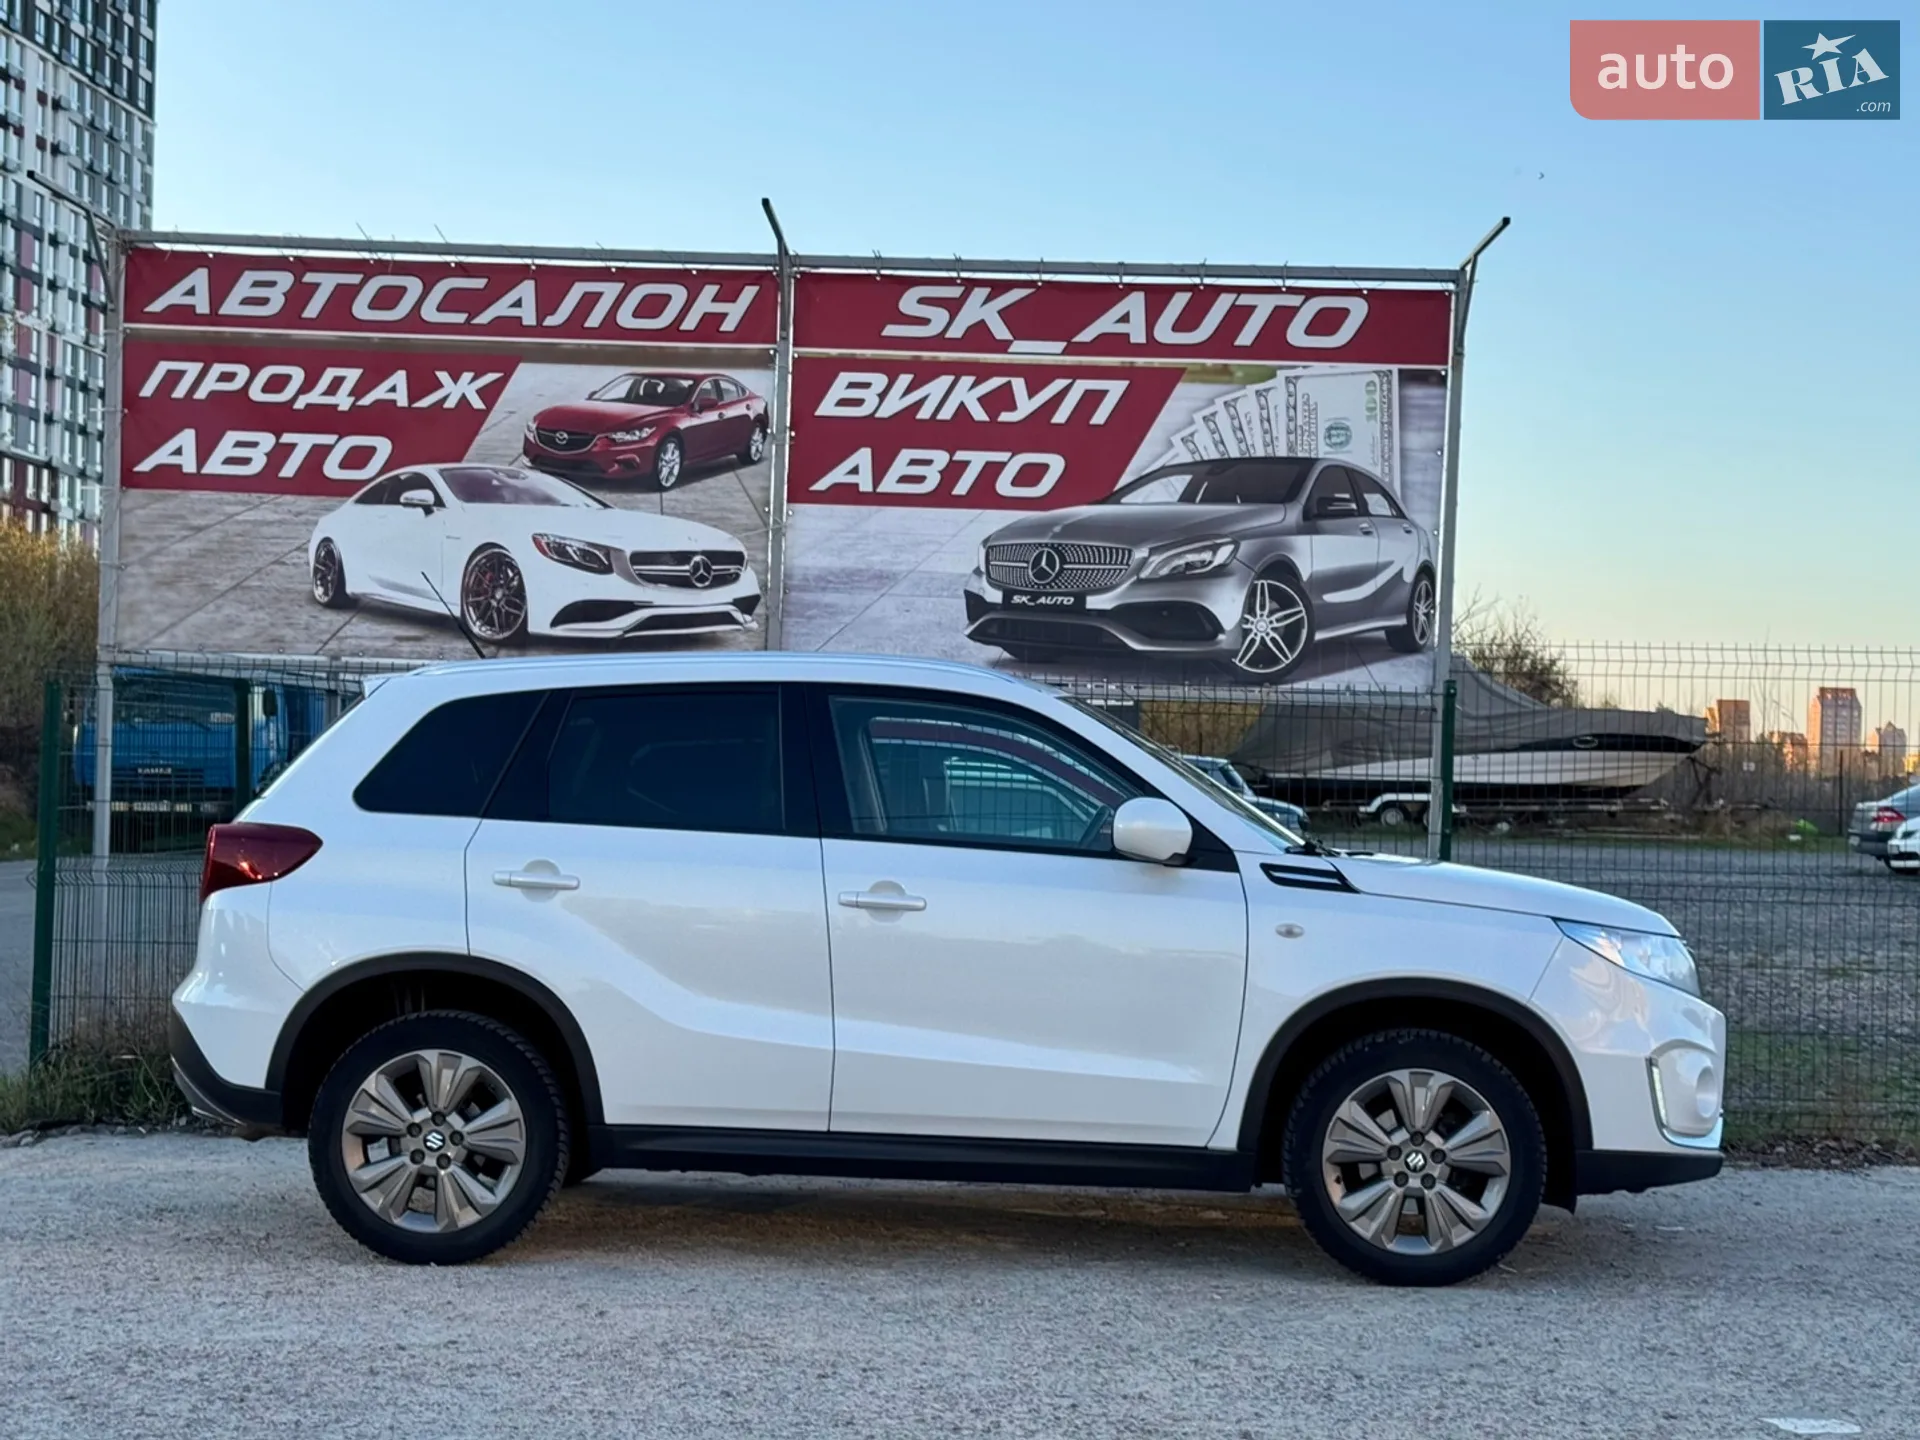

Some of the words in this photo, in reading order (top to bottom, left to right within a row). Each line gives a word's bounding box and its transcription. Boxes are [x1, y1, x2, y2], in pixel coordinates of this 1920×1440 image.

[142, 267, 761, 333] АВТОСАЛОН
[880, 285, 1370, 355] SK_AUTO
[138, 360, 505, 412] ПРОДАЖ
[813, 371, 1131, 425] ВИКУП
[132, 428, 393, 481] АВТО
[808, 447, 1067, 498] АВТО
[1010, 594, 1075, 606] SK_AUTO
